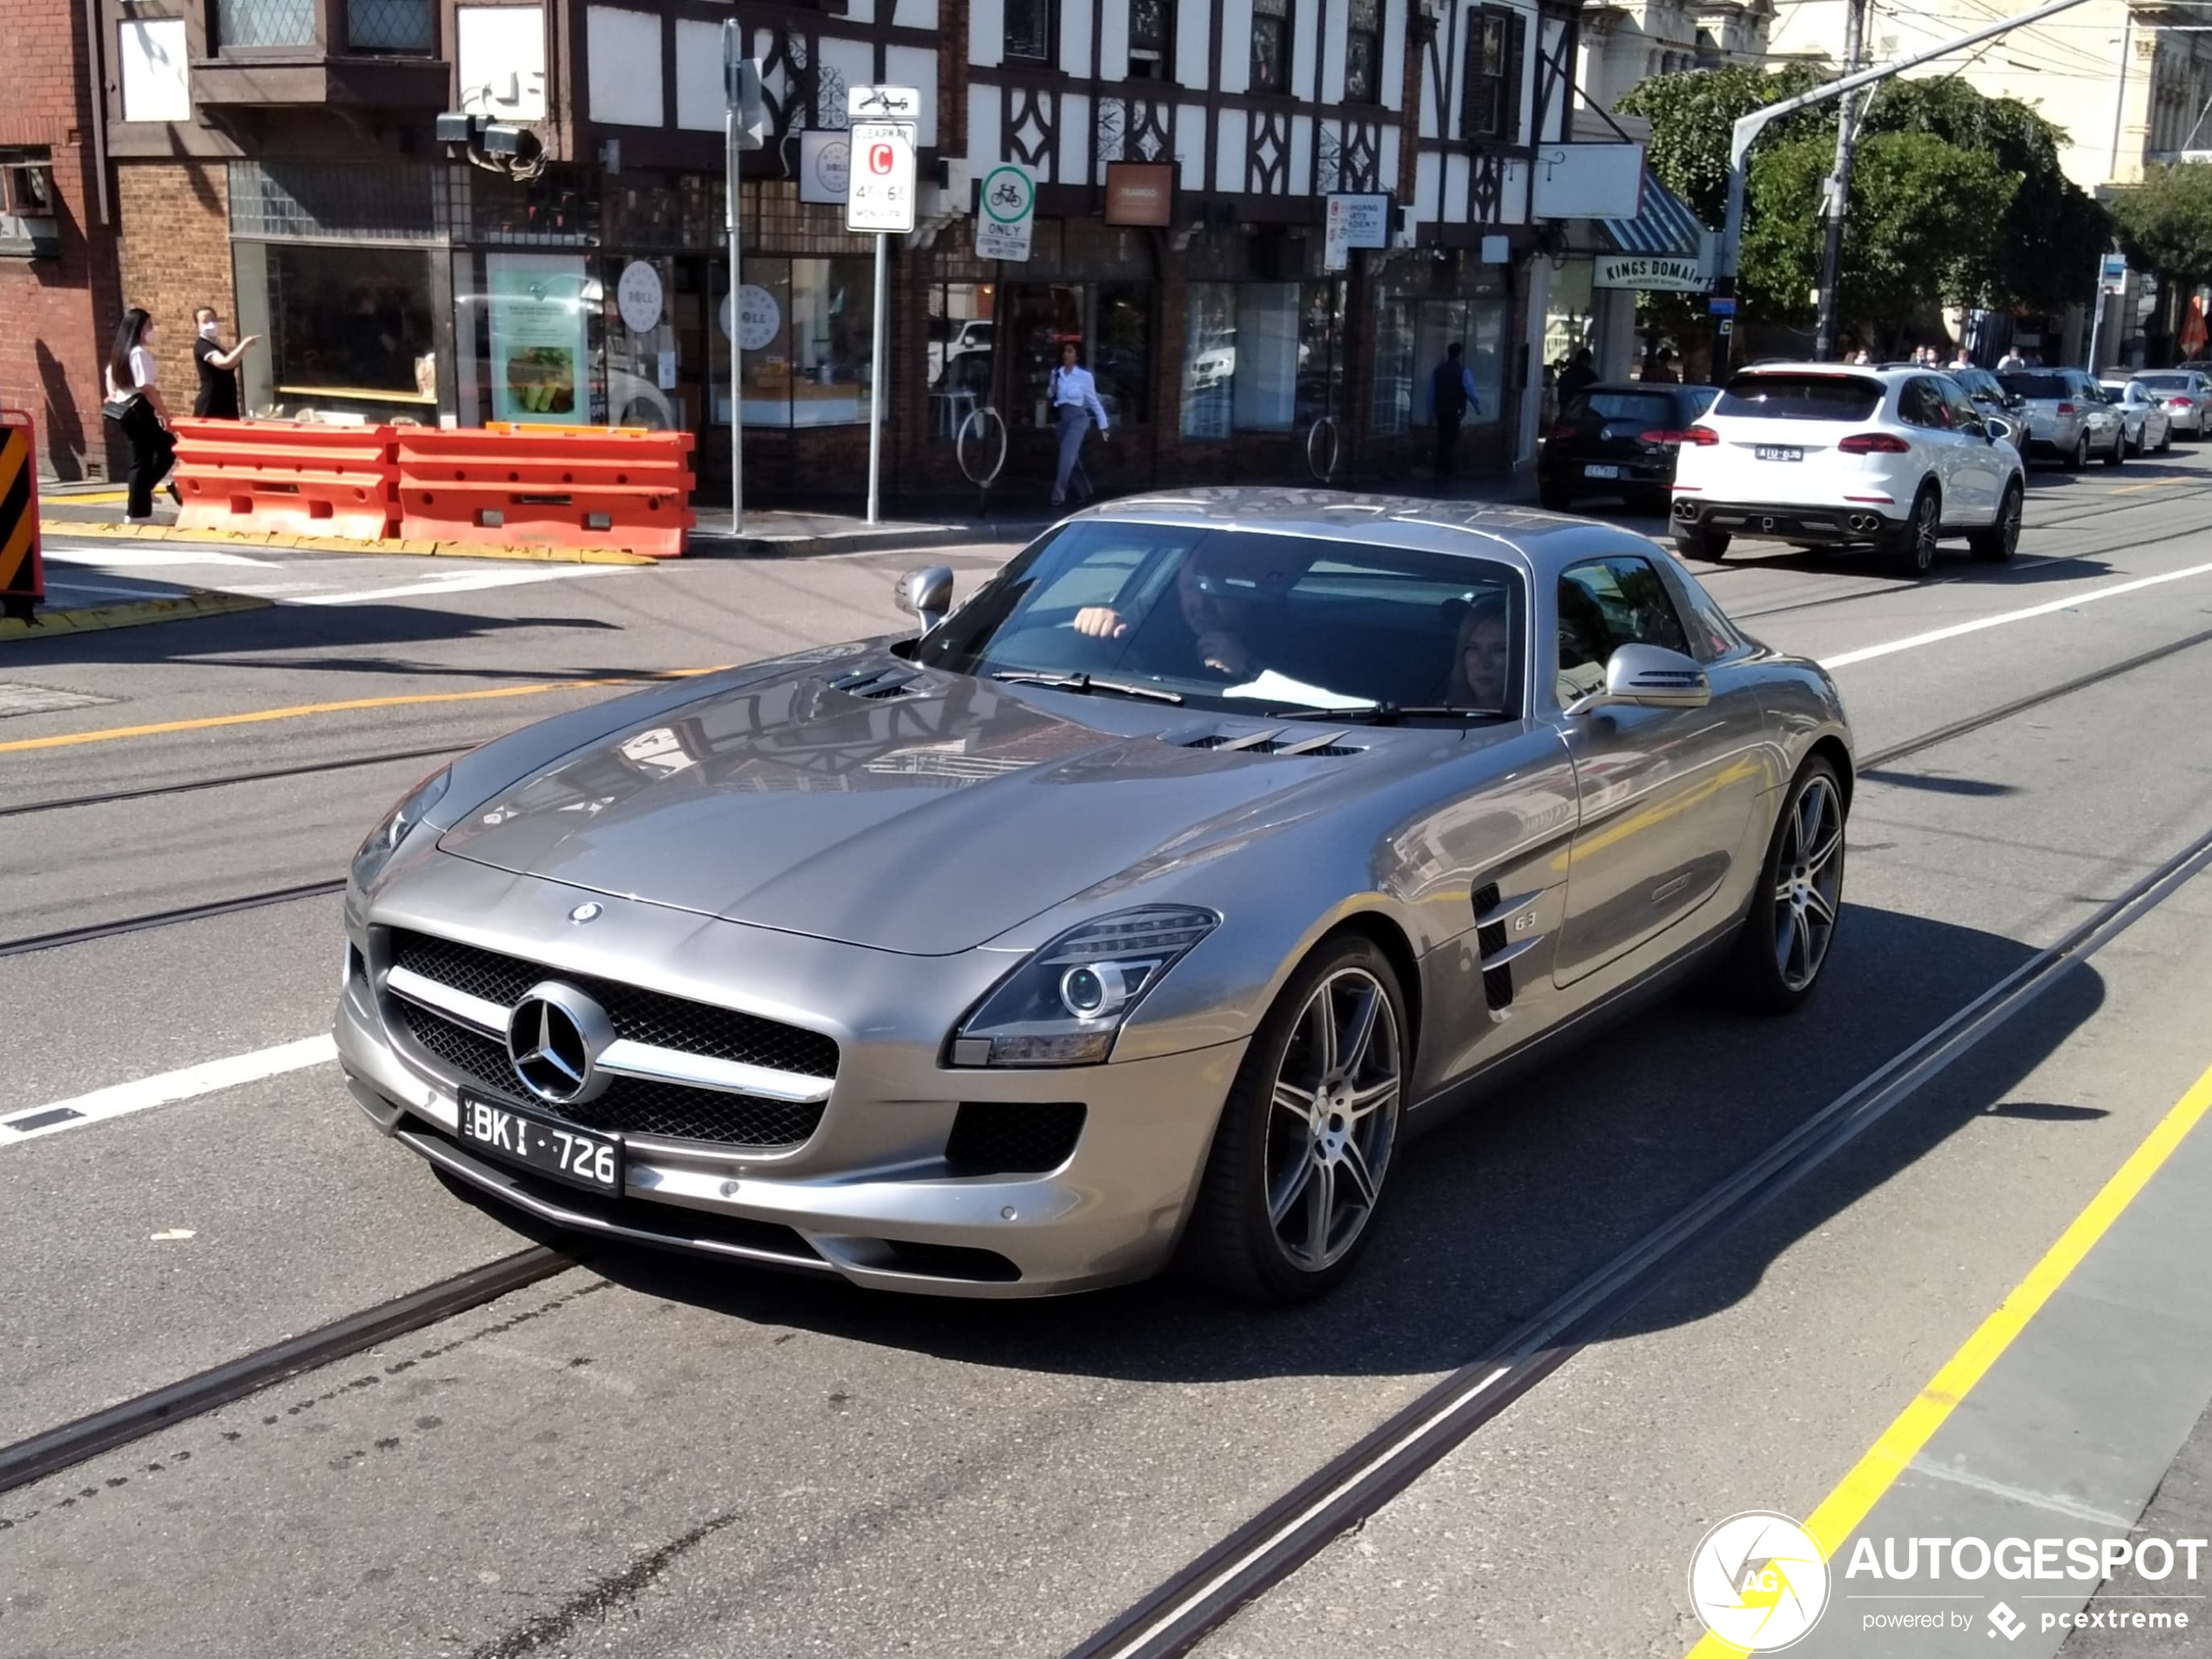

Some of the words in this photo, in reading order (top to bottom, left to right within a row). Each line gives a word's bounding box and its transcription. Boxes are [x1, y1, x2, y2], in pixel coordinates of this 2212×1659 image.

[873, 145, 891, 173] C
[988, 223, 1021, 237] ONLY
[1606, 260, 1647, 281] KINGS
[628, 291, 653, 304] ROLL
[741, 311, 767, 324] OLL
[1514, 911, 1536, 931] 63
[464, 1100, 474, 1136] VIC
